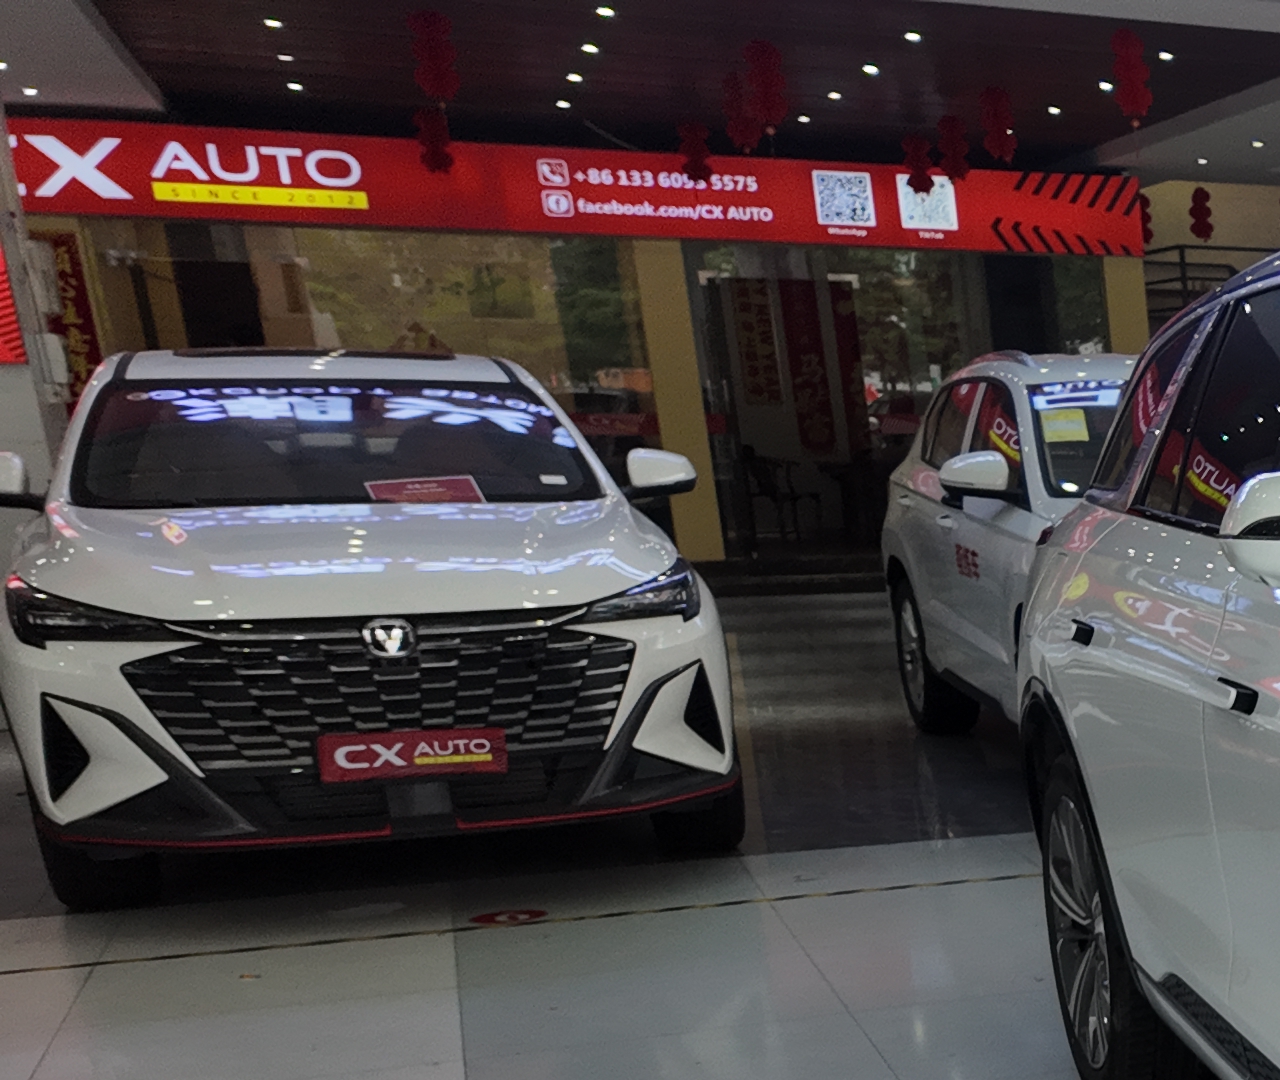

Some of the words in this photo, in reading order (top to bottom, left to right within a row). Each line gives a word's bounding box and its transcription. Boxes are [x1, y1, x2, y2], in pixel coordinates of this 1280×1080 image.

[8, 134, 134, 200] X
[151, 140, 362, 187] AUTO
[573, 167, 613, 185] +86
[617, 169, 654, 188] 133
[710, 173, 758, 193] 5575
[171, 187, 261, 202] SINCE
[287, 190, 356, 206] 2012
[576, 198, 724, 220] facebook.com/CX
[727, 205, 773, 222] AUTO
[334, 742, 408, 769] CX
[414, 738, 490, 756] AUTO
